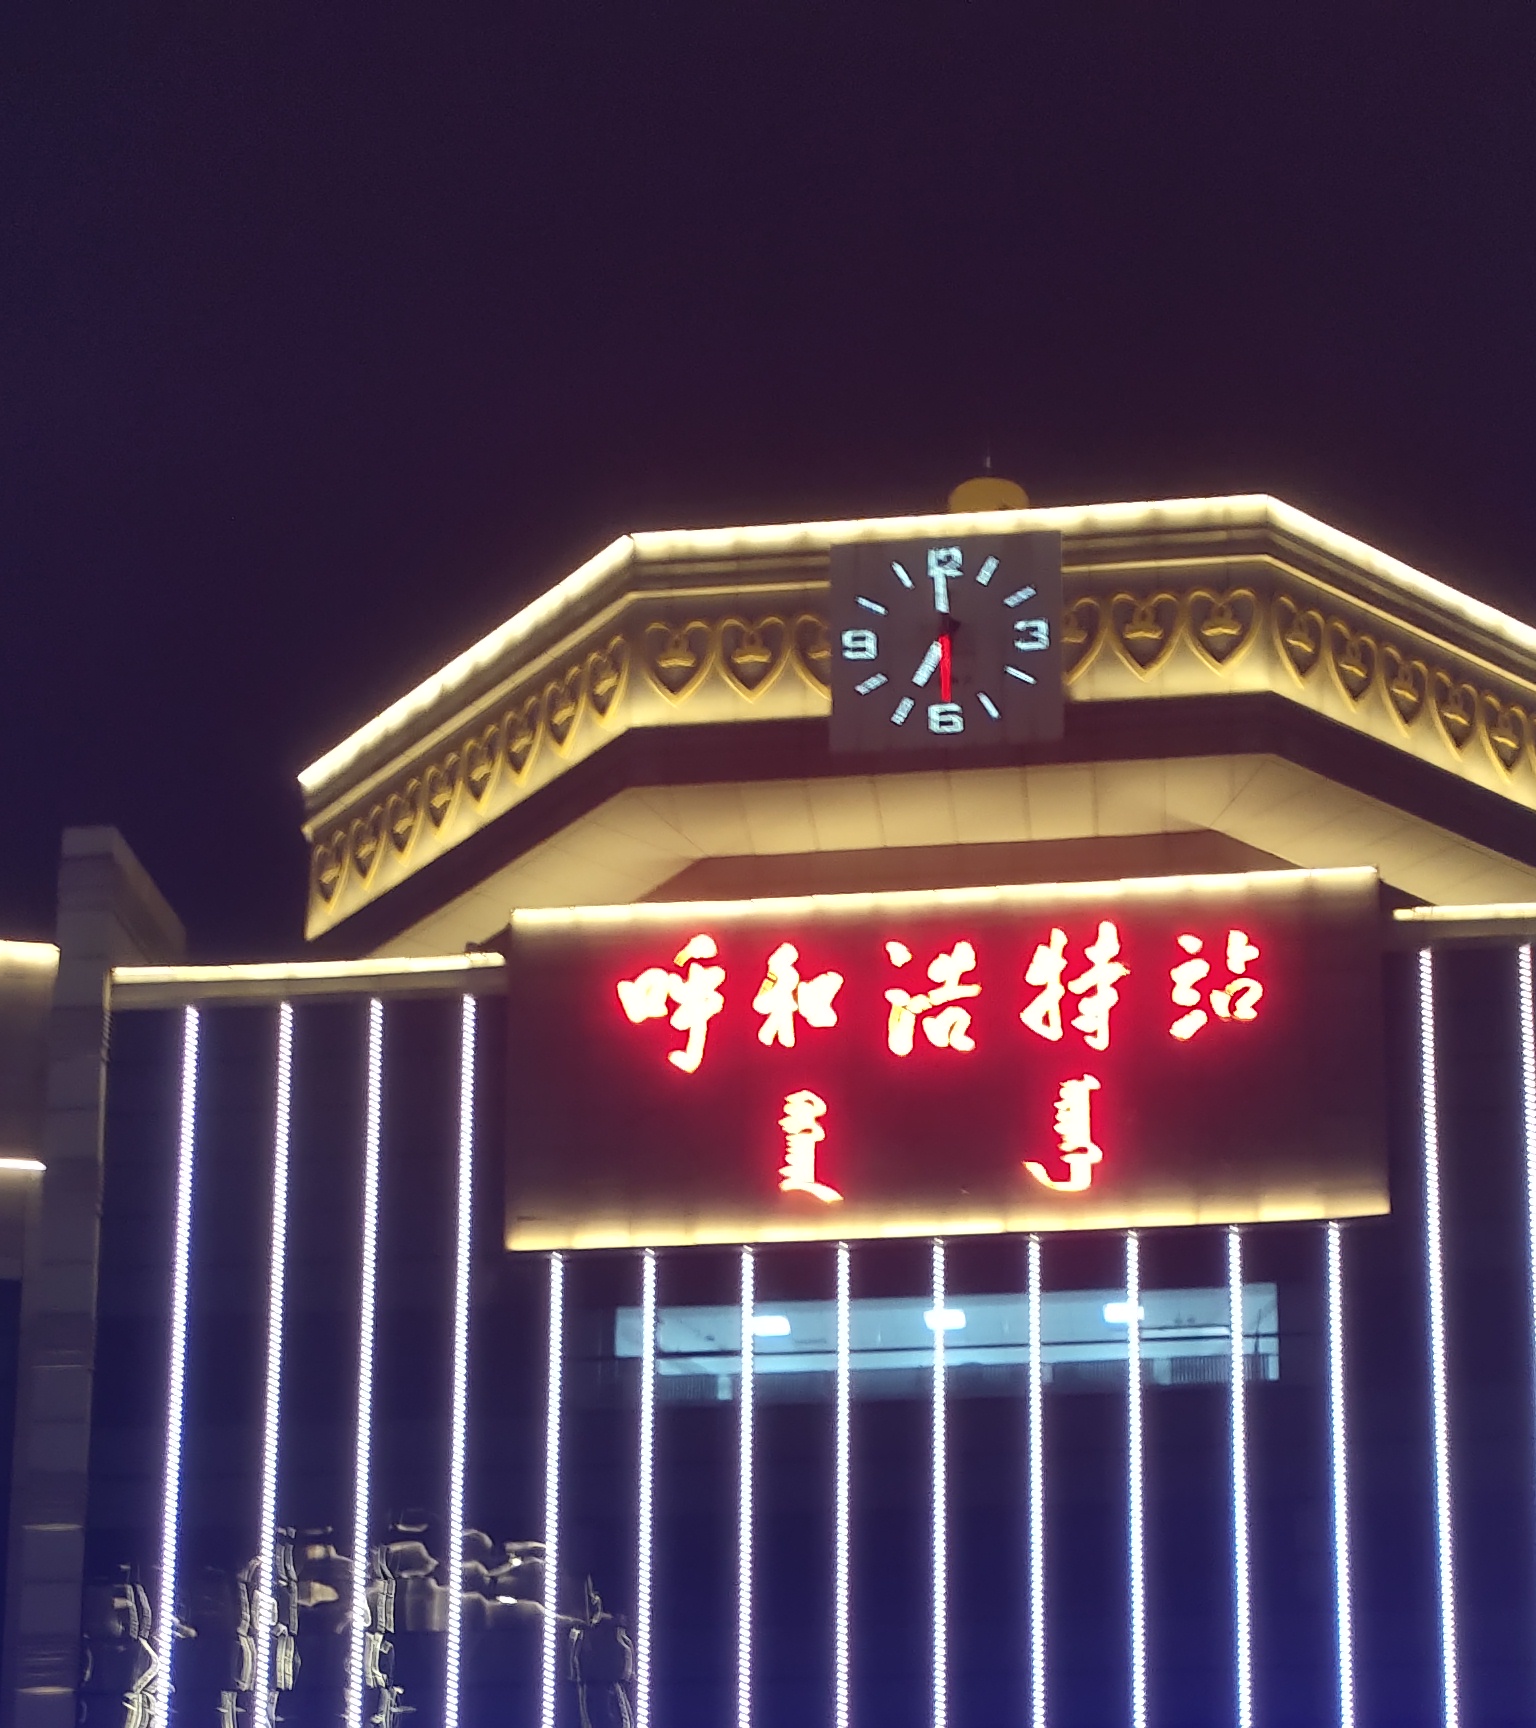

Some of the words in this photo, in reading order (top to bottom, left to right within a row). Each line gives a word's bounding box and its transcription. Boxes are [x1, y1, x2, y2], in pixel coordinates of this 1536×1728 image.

[842, 629, 878, 660] 9
[1014, 618, 1050, 651] 3
[927, 702, 964, 735] 6
[617, 921, 1263, 1073] 呼和浩特站
